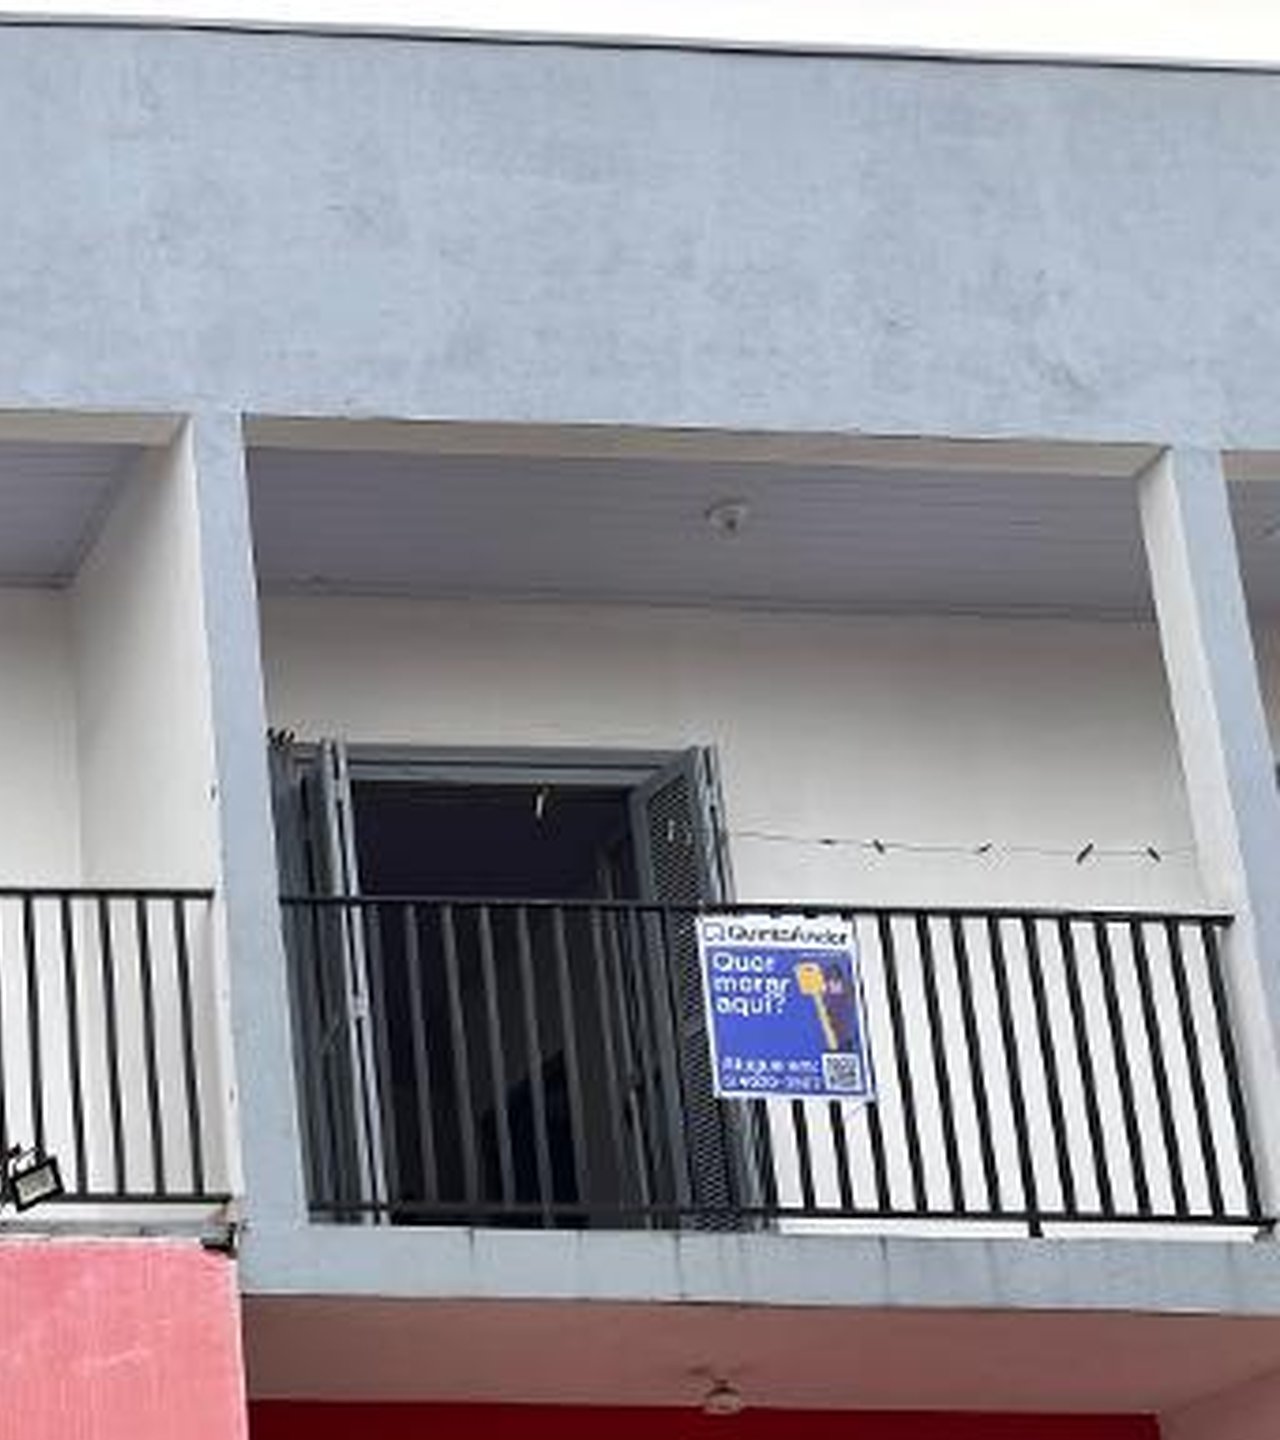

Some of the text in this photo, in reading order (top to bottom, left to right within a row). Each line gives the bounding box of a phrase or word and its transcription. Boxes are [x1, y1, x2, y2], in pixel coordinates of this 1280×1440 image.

[712, 951, 775, 973] Quer
[713, 975, 791, 995] morar
[716, 995, 786, 1016] aqui?
